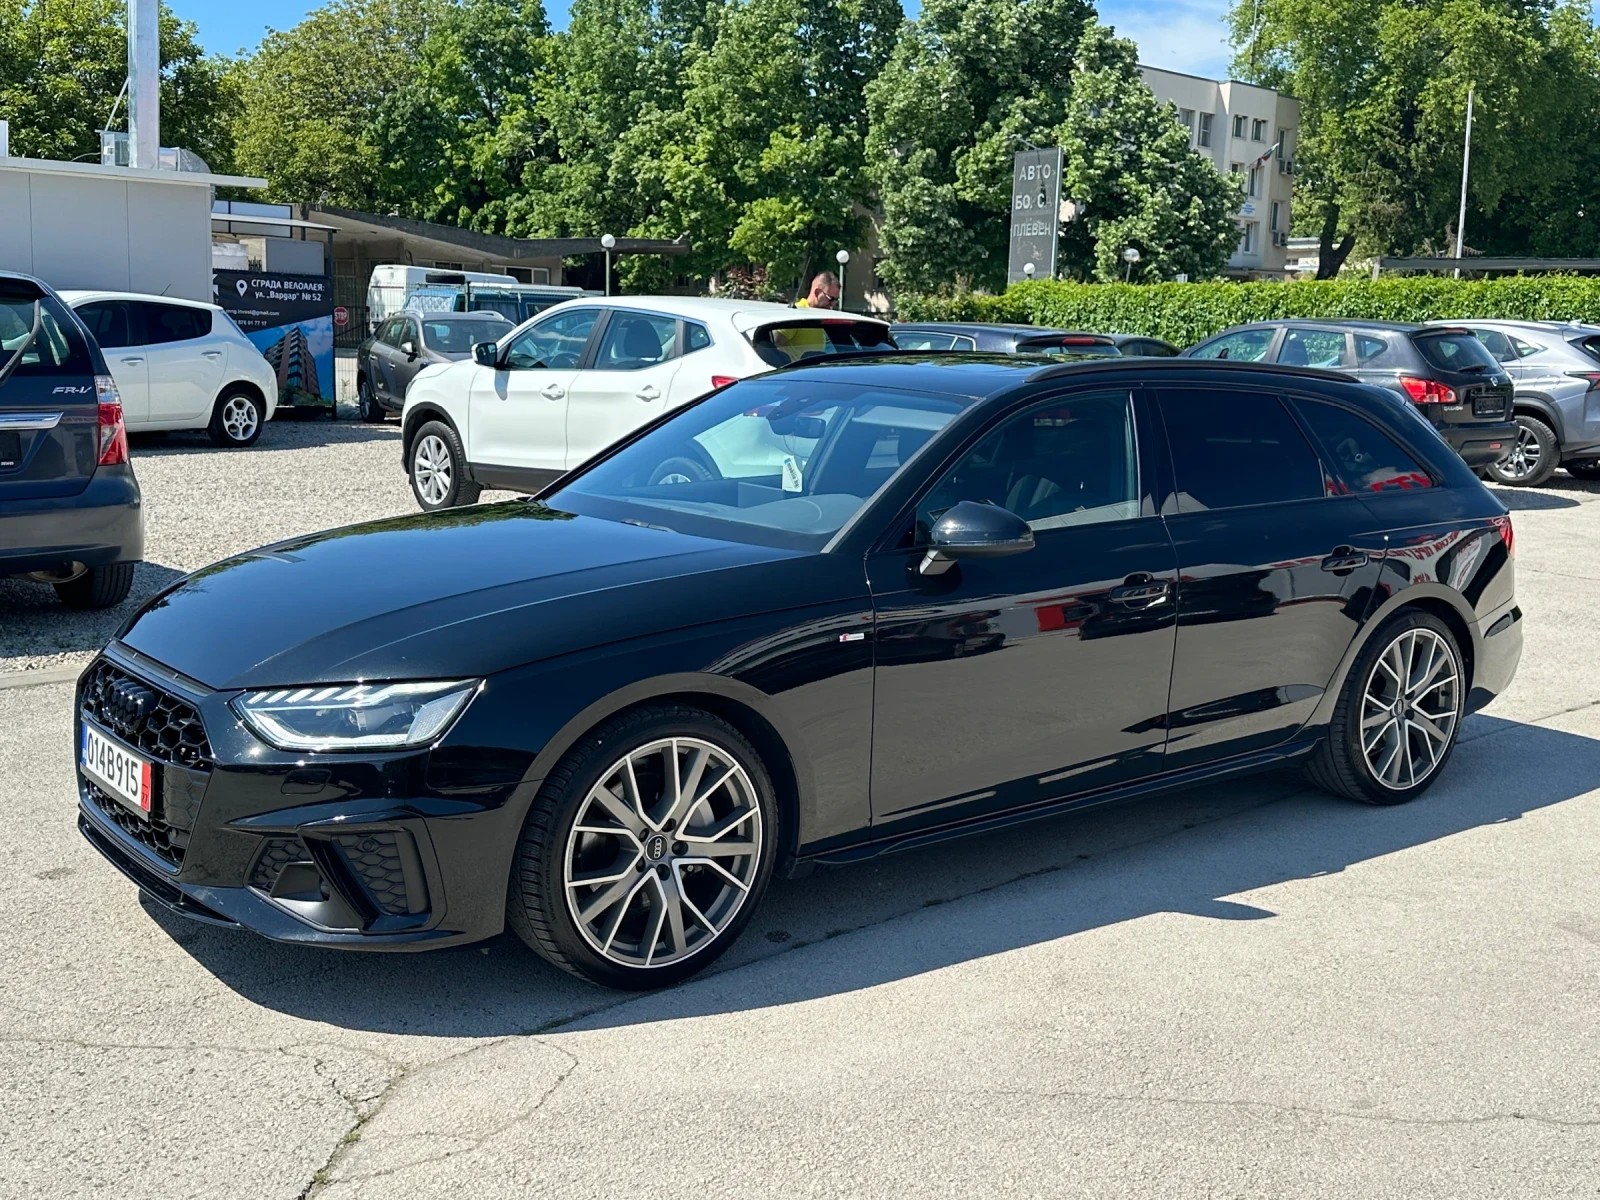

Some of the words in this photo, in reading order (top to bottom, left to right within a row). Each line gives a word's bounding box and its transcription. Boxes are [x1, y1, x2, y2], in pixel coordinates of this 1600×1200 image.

[1019, 164, 1051, 181] АВТО
[1013, 222, 1052, 237] ПЛЕВЕН
[251, 279, 282, 290] СГРАДА
[312, 293, 322, 302] 52
[52, 386, 93, 394] FR-V
[87, 732, 139, 797] 014B915
